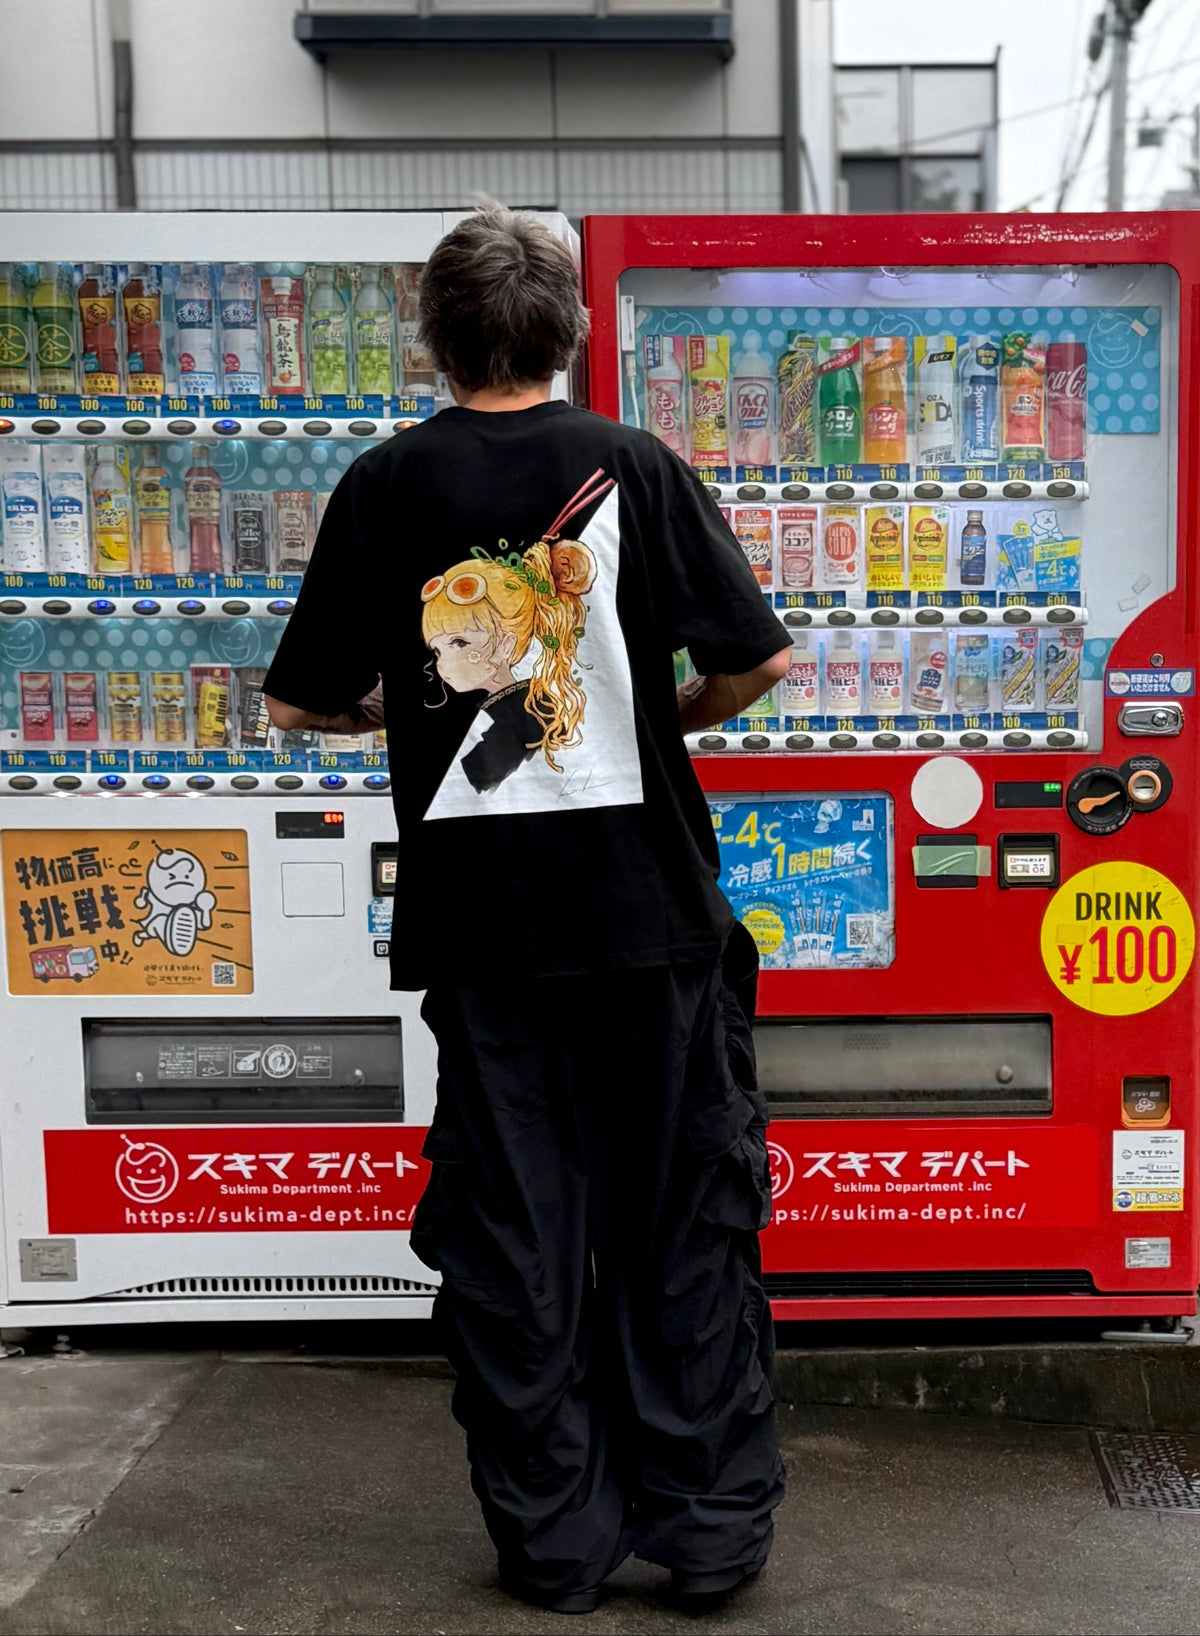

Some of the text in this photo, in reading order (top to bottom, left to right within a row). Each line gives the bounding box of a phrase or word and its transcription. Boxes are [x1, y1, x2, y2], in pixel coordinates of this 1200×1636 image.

[39, 325, 70, 361] 茶
[275, 323, 293, 369] 烏龍茶
[38, 398, 56, 410] 100
[80, 399, 99, 411] 100
[126, 400, 144, 412] 100
[168, 400, 187, 411] 100
[212, 399, 230, 411] 100
[259, 399, 277, 410] 100
[304, 399, 323, 410] 100
[345, 399, 364, 410] 100
[399, 400, 418, 412] 130
[656, 392, 676, 429] もも
[826, 410, 855, 421] メロン
[825, 421, 854, 432] ソーダ
[868, 423, 897, 434] ソーダ
[699, 470, 717, 482] 100
[745, 469, 763, 481] 150
[790, 471, 808, 482] 120
[836, 469, 852, 481] 110
[881, 468, 897, 479] 110
[922, 469, 940, 481] 100
[965, 469, 983, 481] 100
[1008, 469, 1026, 480] 120
[1052, 467, 1070, 479] 150
[784, 537, 810, 547] ココア
[829, 537, 852, 556] SODA
[4, 576, 23, 587] 100
[48, 576, 66, 587] 100
[87, 579, 105, 590] 100
[134, 579, 152, 590] 120
[176, 577, 194, 589] 120
[224, 577, 243, 589] 100
[265, 578, 284, 590] 100
[785, 595, 804, 607] 100
[816, 595, 832, 606] 110
[877, 595, 894, 605] 110
[926, 595, 943, 606] 110
[960, 595, 979, 606] 100
[748, 721, 767, 732] 100
[792, 720, 809, 731] 120
[836, 720, 854, 731] 120
[878, 720, 895, 731] 120
[918, 720, 936, 731] 120
[963, 717, 979, 728] 110
[1002, 716, 1020, 728] 100
[1047, 716, 1065, 728] 100
[8, 755, 24, 766] 110
[49, 755, 66, 766] 110
[99, 754, 115, 766] 110
[140, 755, 158, 766] 110
[186, 755, 204, 766] 100
[227, 755, 246, 766] 100
[273, 754, 291, 765] 120
[320, 755, 338, 766] 120
[362, 755, 381, 766] 120
[14, 846, 114, 890] 物価高に
[727, 838, 873, 888] 冷感1時間続く
[1075, 892, 1163, 920] DRINK
[19, 884, 125, 945] 挑戦
[1057, 925, 1176, 985] ¥100
[187, 1151, 418, 1180] スキマ デパート
[802, 1150, 1031, 1178] スキマ デパート
[220, 1182, 382, 1197] Sukima Department .inc
[833, 1181, 993, 1194] Sukima Department .inc
[125, 1205, 417, 1228] https://sukima-dept.inc/
[771, 1203, 1027, 1224] ps://sukima-dept.inc/
